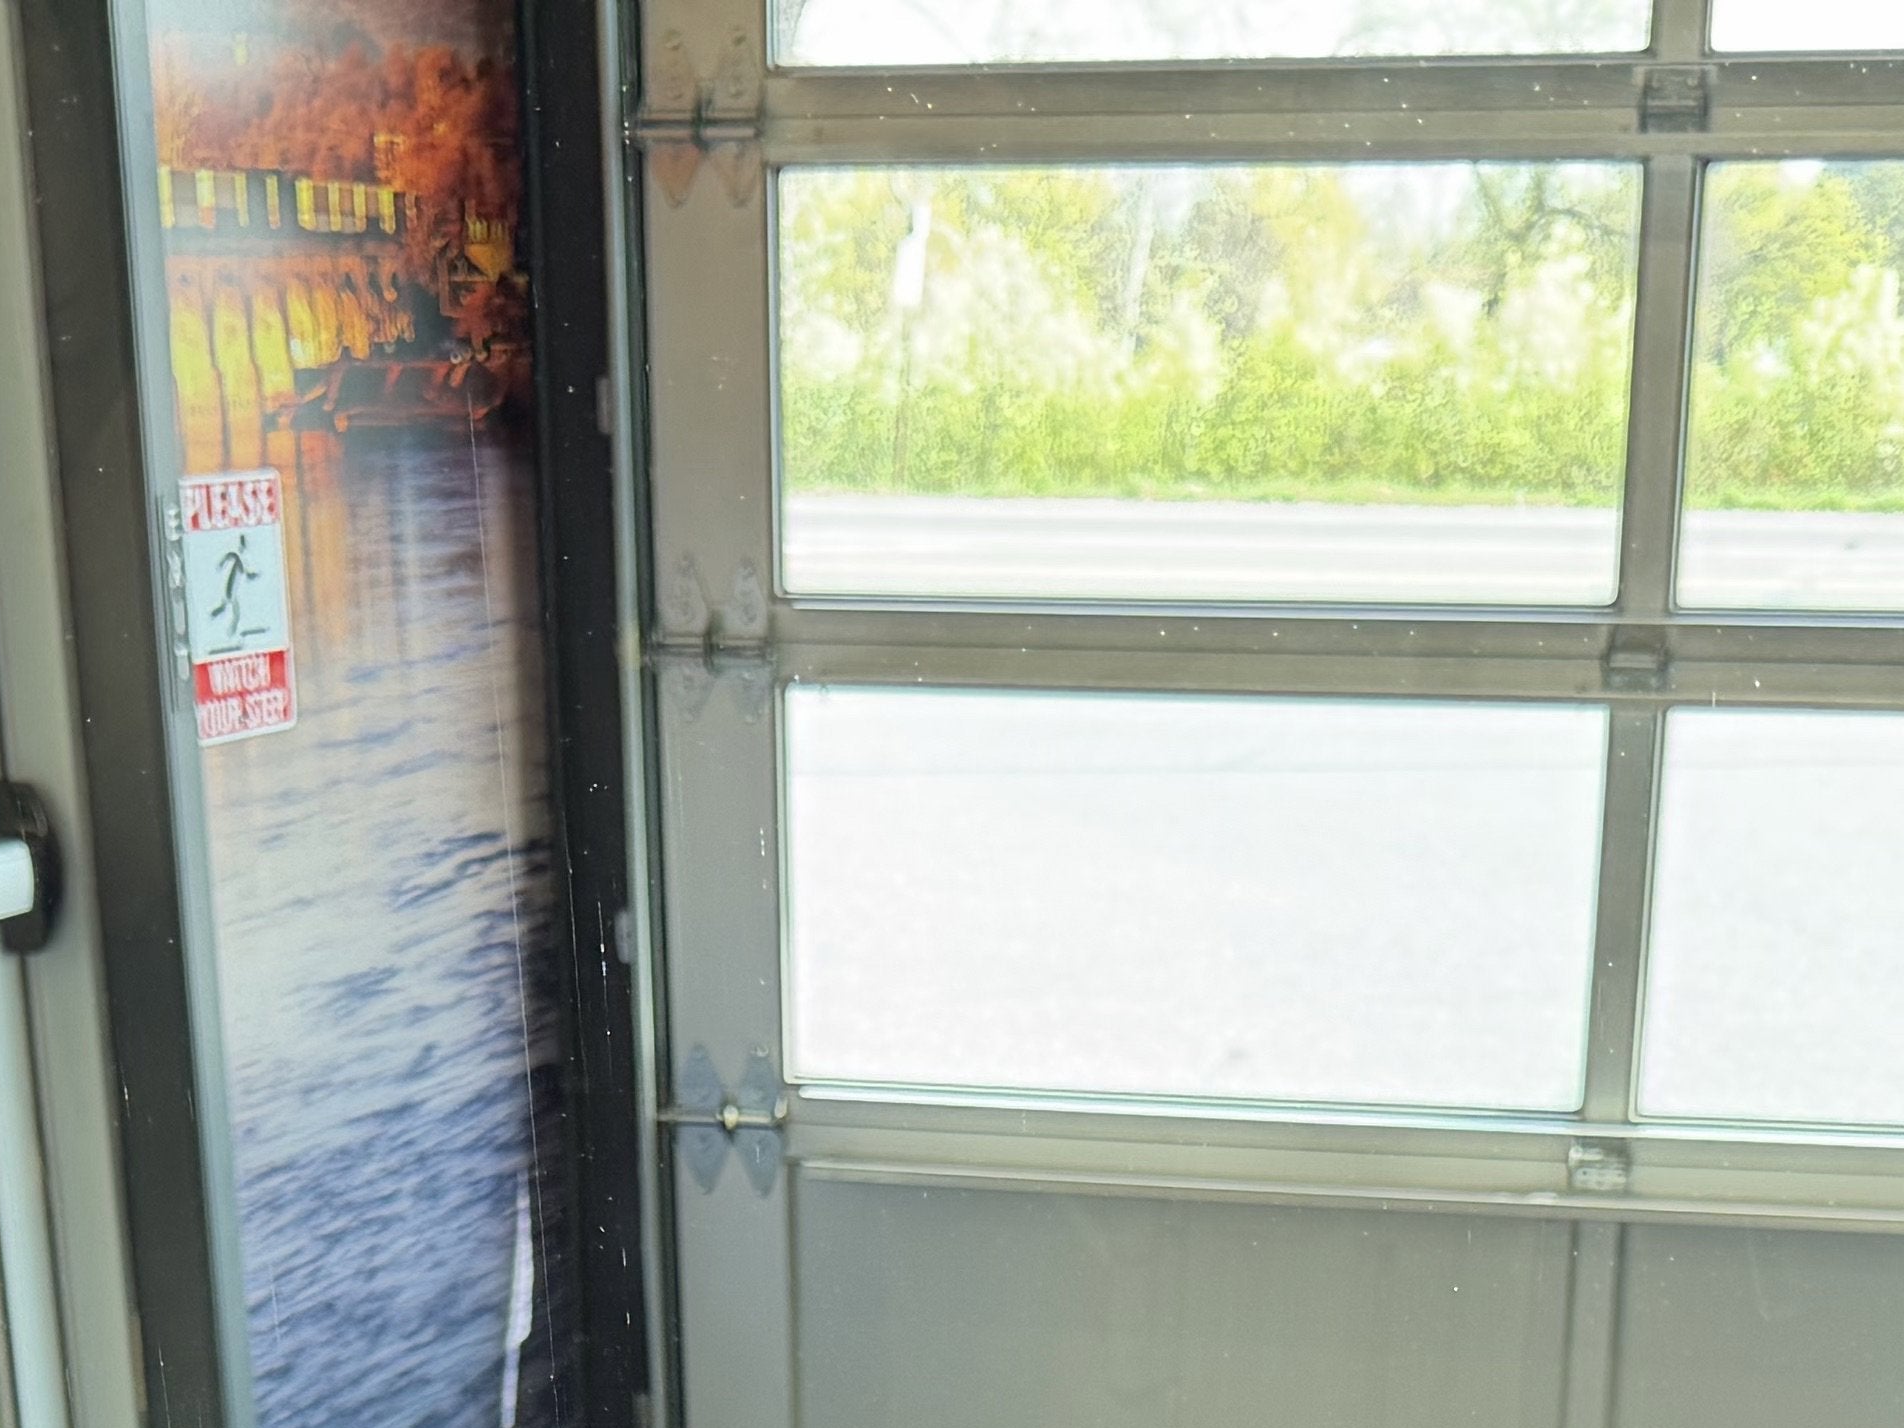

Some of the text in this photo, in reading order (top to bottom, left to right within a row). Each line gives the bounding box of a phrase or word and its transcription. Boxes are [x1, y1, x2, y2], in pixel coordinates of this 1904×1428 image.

[183, 480, 277, 531] PLEASE
[207, 655, 270, 695] WATCH
[244, 689, 287, 729] STEP
